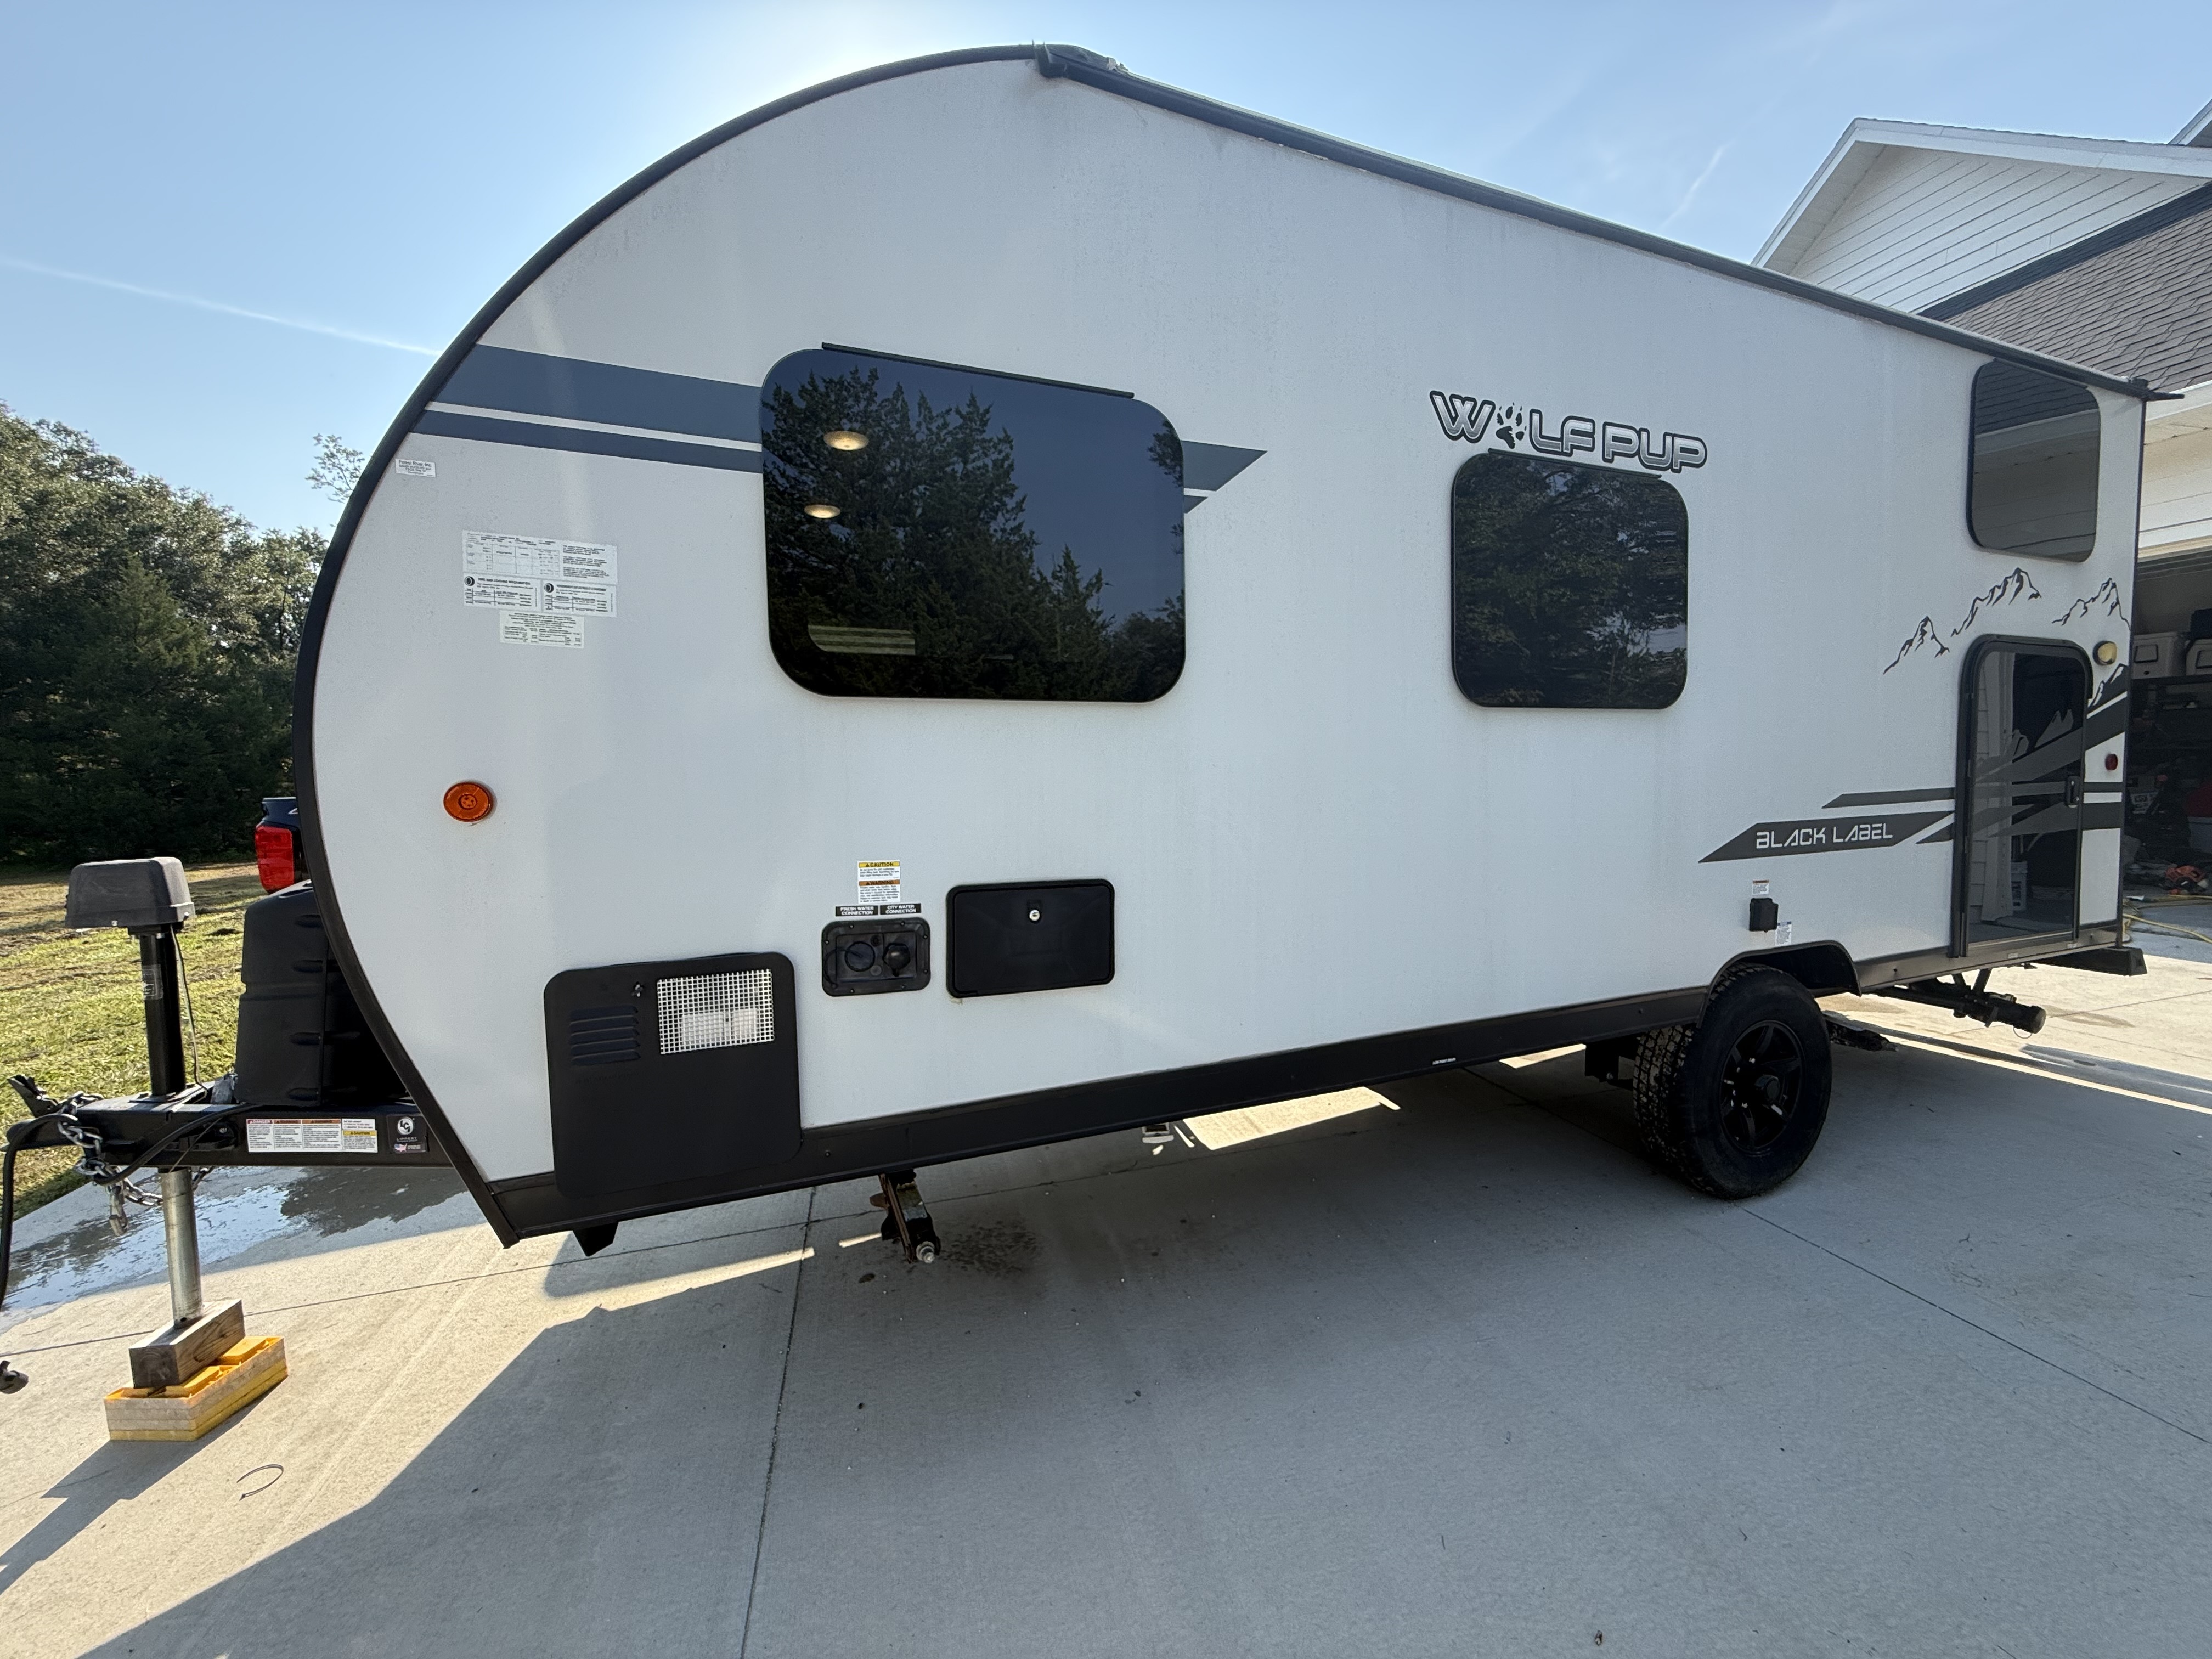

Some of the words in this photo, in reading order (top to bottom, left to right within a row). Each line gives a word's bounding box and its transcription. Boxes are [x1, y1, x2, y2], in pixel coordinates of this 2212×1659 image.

[1430, 390, 1595, 456] WLF
[1602, 421, 1707, 473] PUP
[1756, 827, 1826, 849] BLACK
[1832, 823, 1893, 843] LABEL
